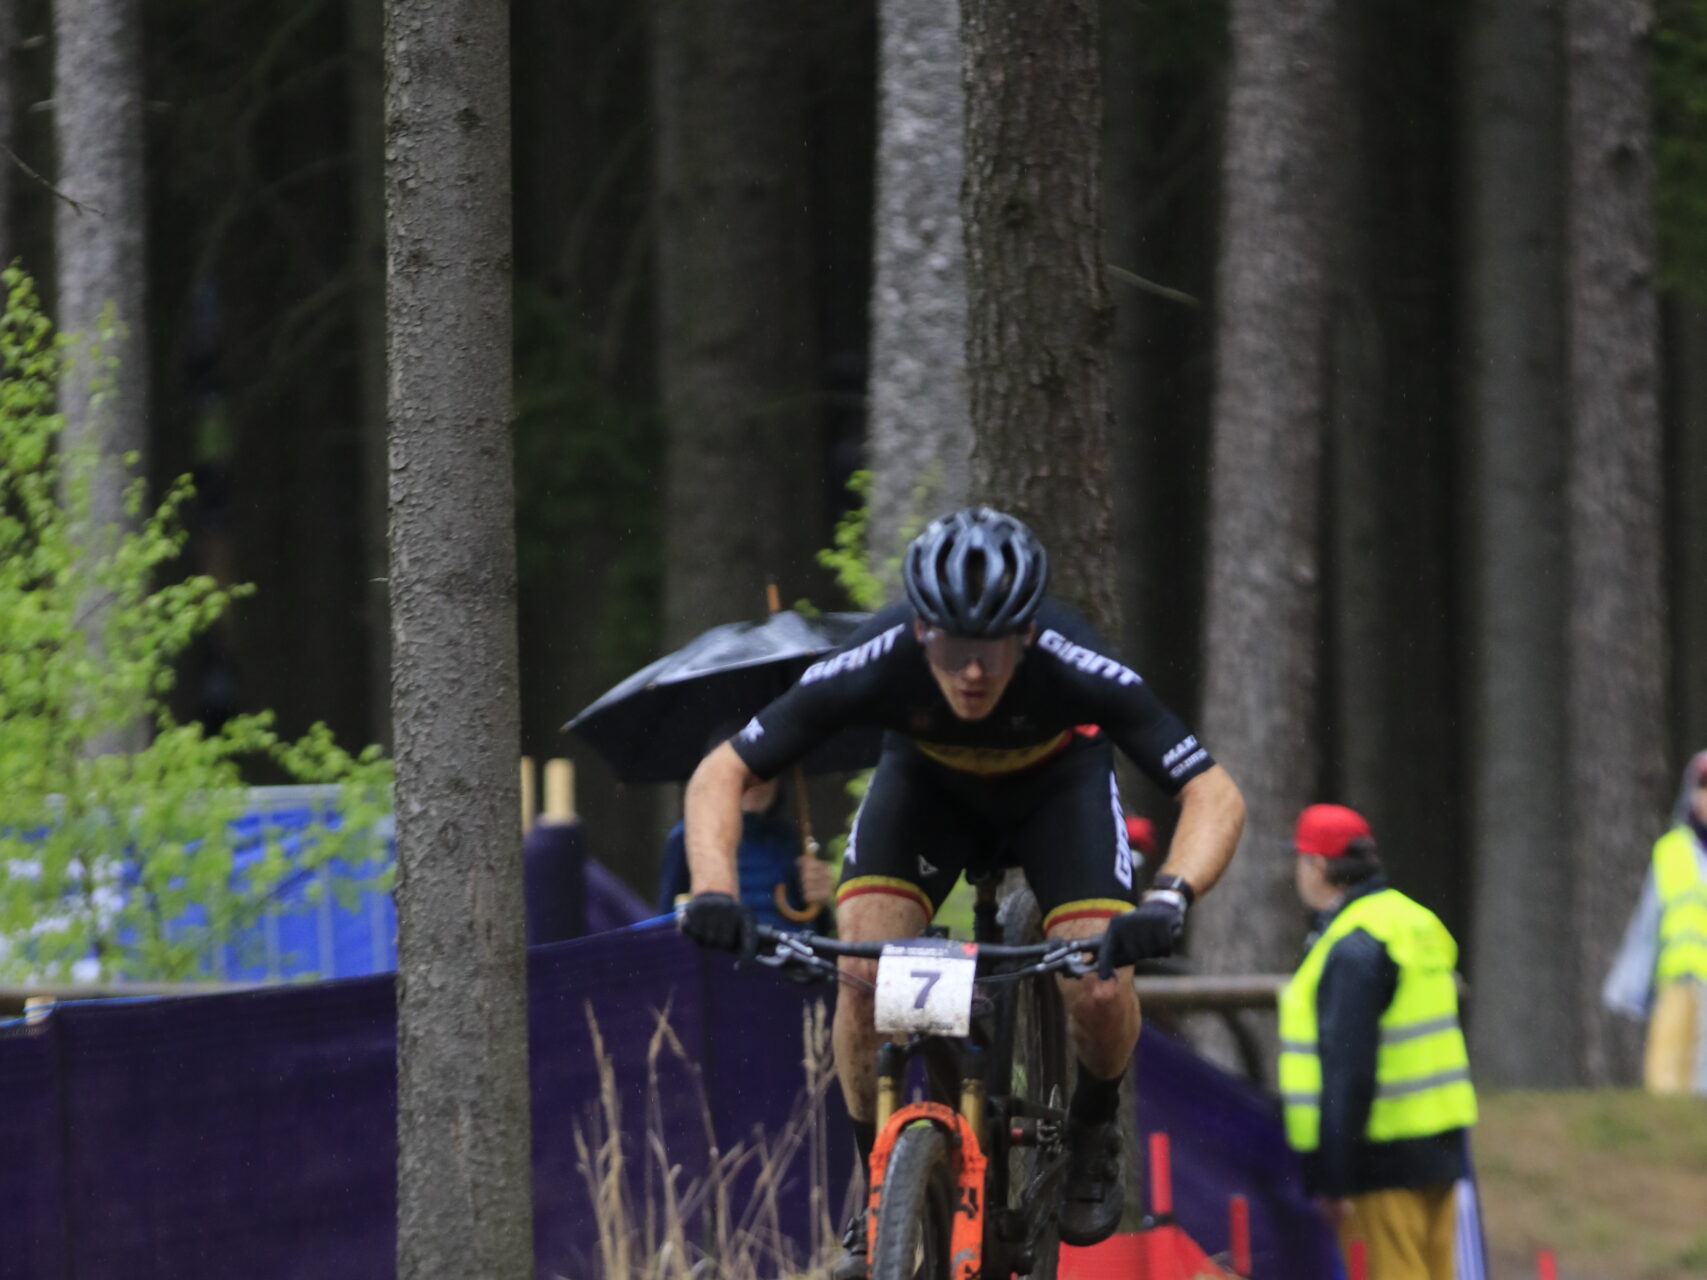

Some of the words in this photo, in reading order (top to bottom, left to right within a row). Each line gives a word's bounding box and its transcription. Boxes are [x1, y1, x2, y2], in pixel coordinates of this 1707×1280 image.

[799, 623, 905, 686] GIANT
[1037, 629, 1142, 684] GIANT
[910, 971, 941, 1009] 7
